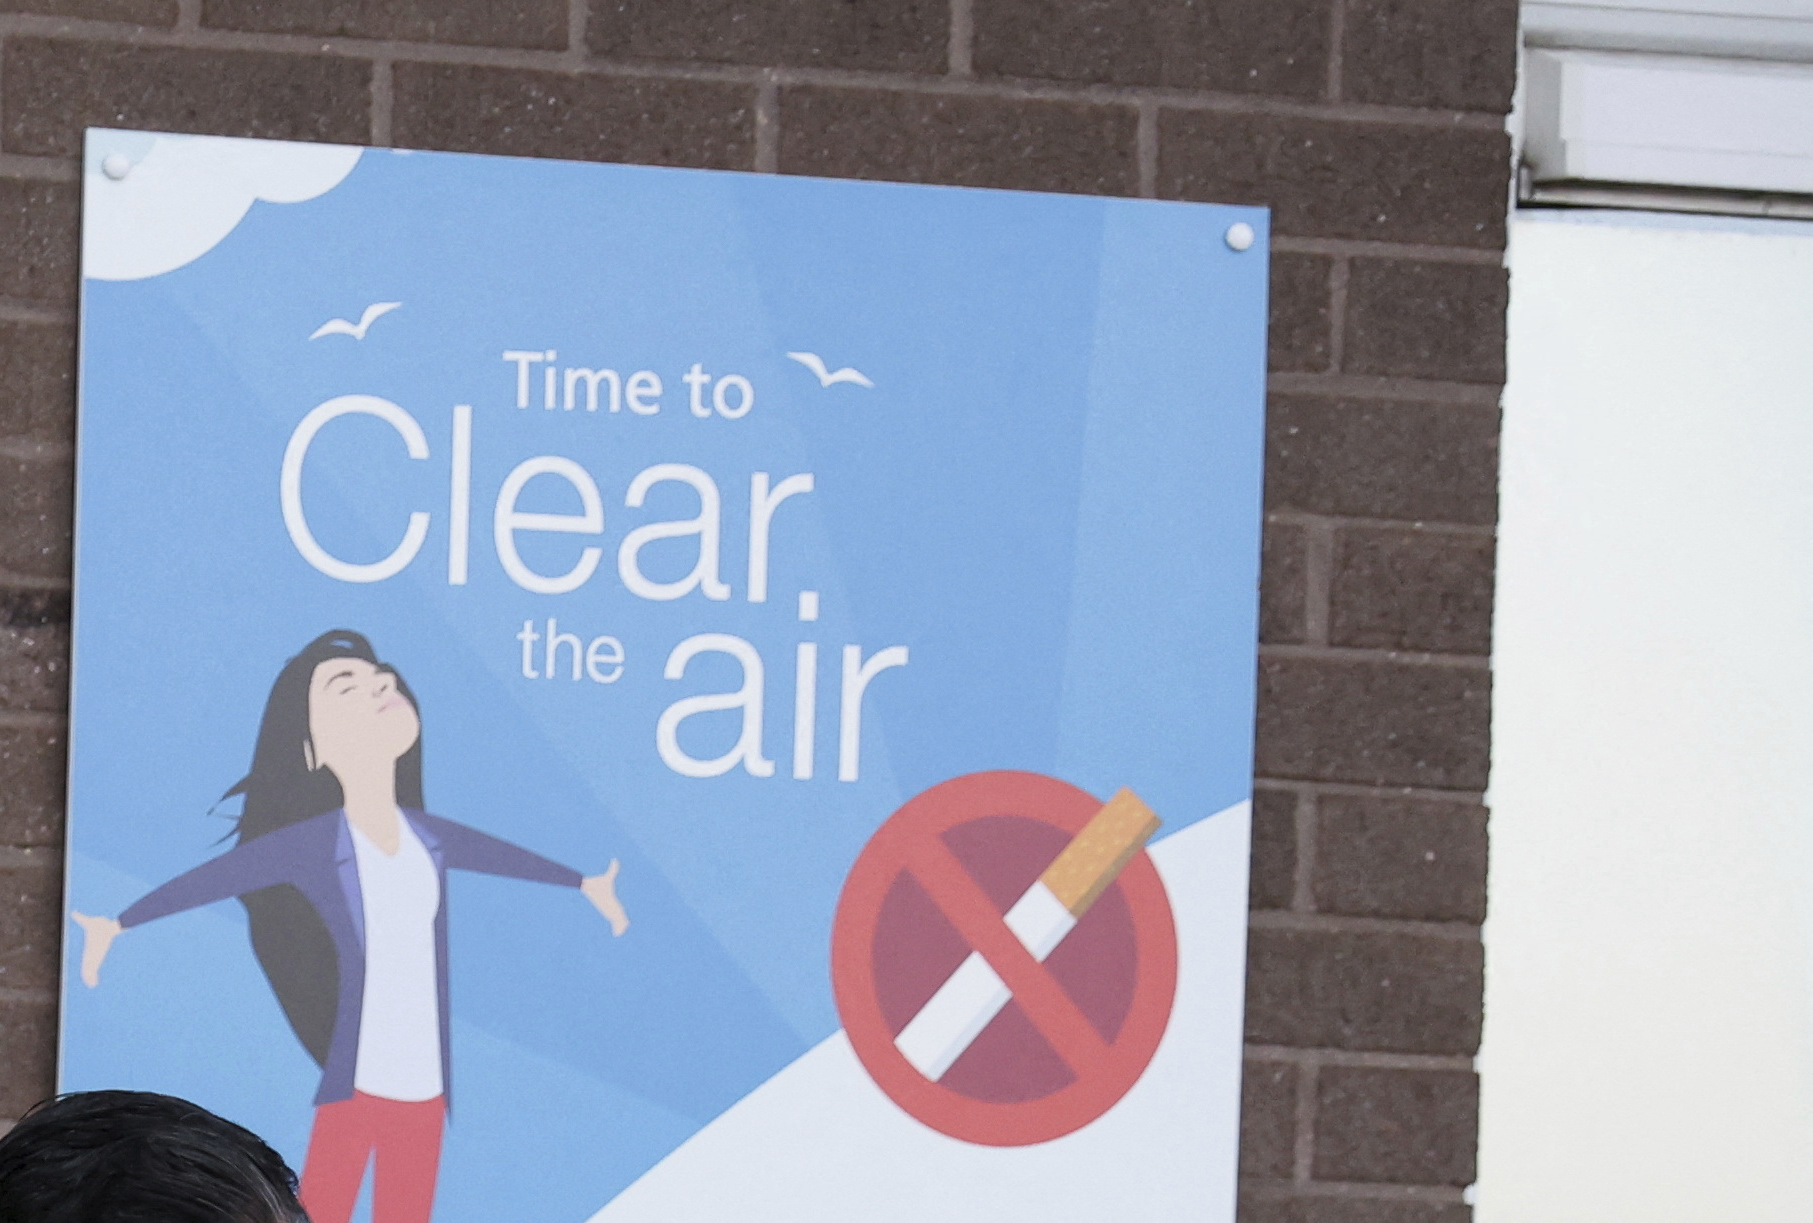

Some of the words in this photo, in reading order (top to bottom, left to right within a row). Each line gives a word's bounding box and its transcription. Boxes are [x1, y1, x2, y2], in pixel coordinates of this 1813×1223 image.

[503, 350, 663, 415] Time
[683, 362, 755, 419] to
[280, 394, 814, 602] Clear
[516, 618, 625, 684] the
[655, 590, 910, 783] air
